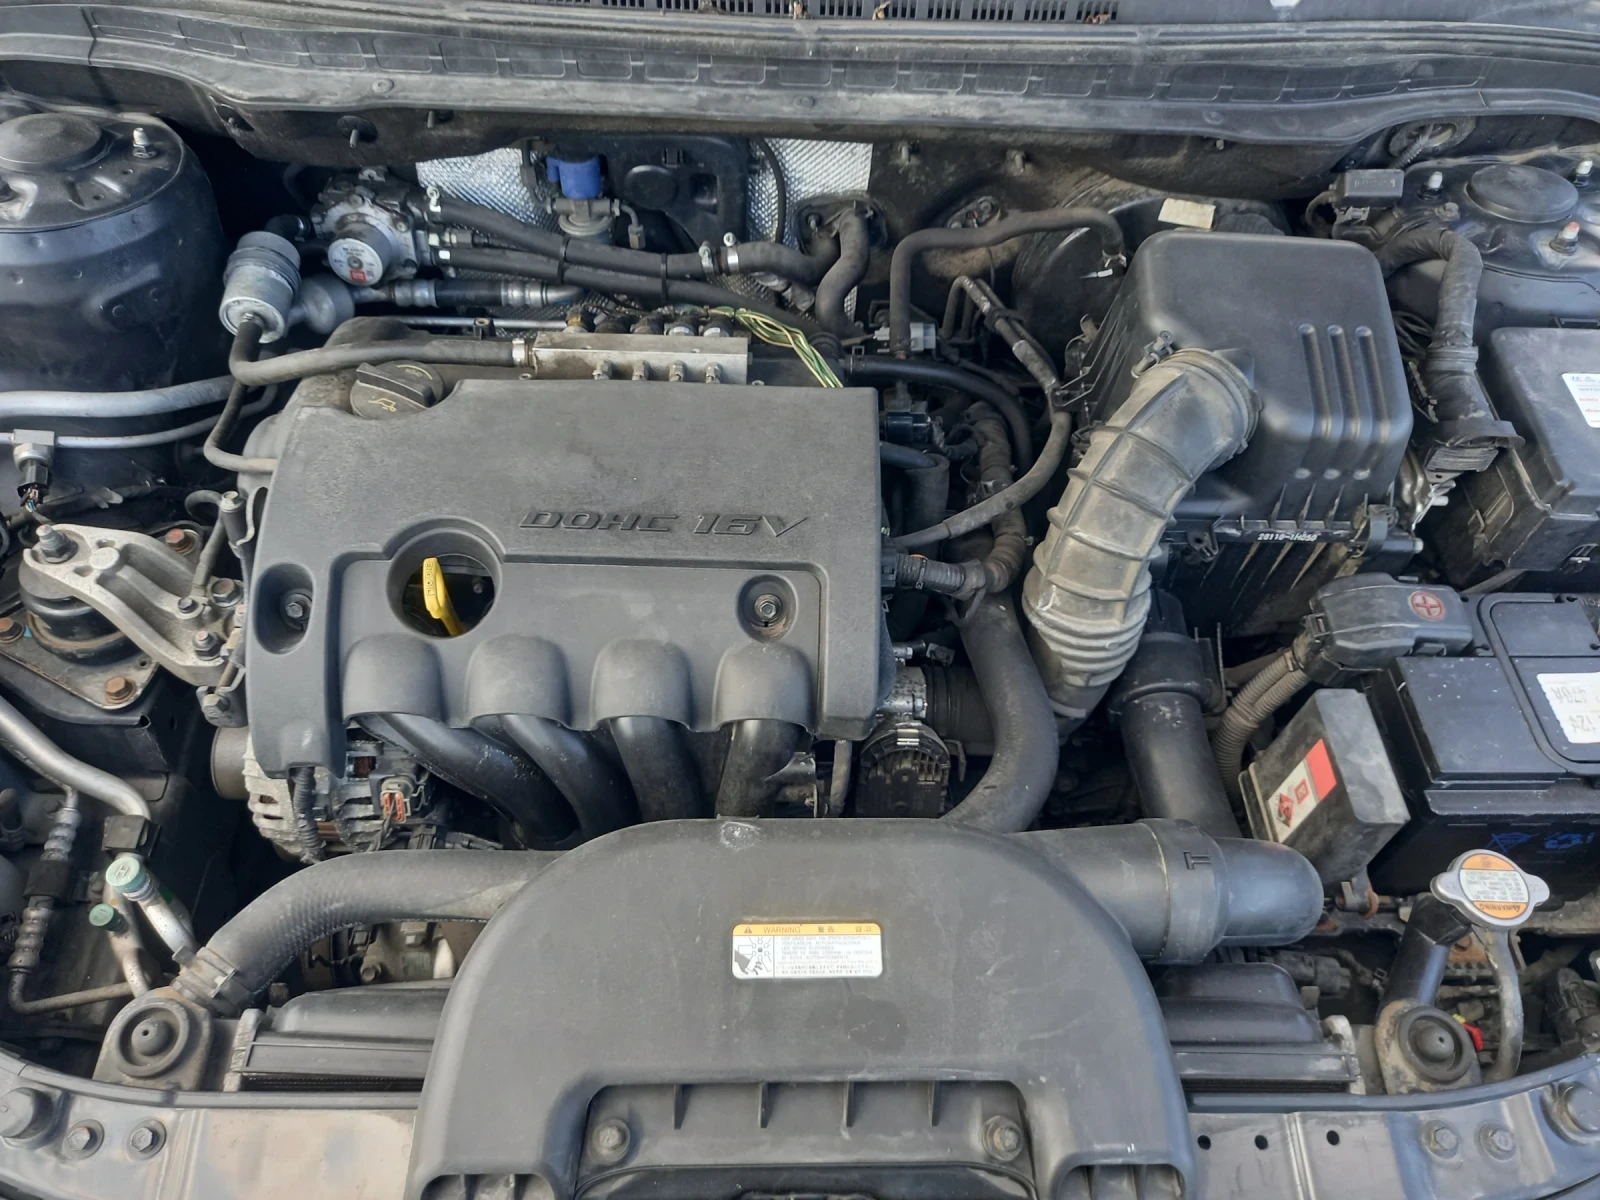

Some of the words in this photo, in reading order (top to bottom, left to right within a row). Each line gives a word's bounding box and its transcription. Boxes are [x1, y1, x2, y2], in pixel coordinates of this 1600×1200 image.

[518, 511, 679, 532] DOHC
[693, 513, 809, 538] 16V
[763, 926, 801, 934] WARNING
